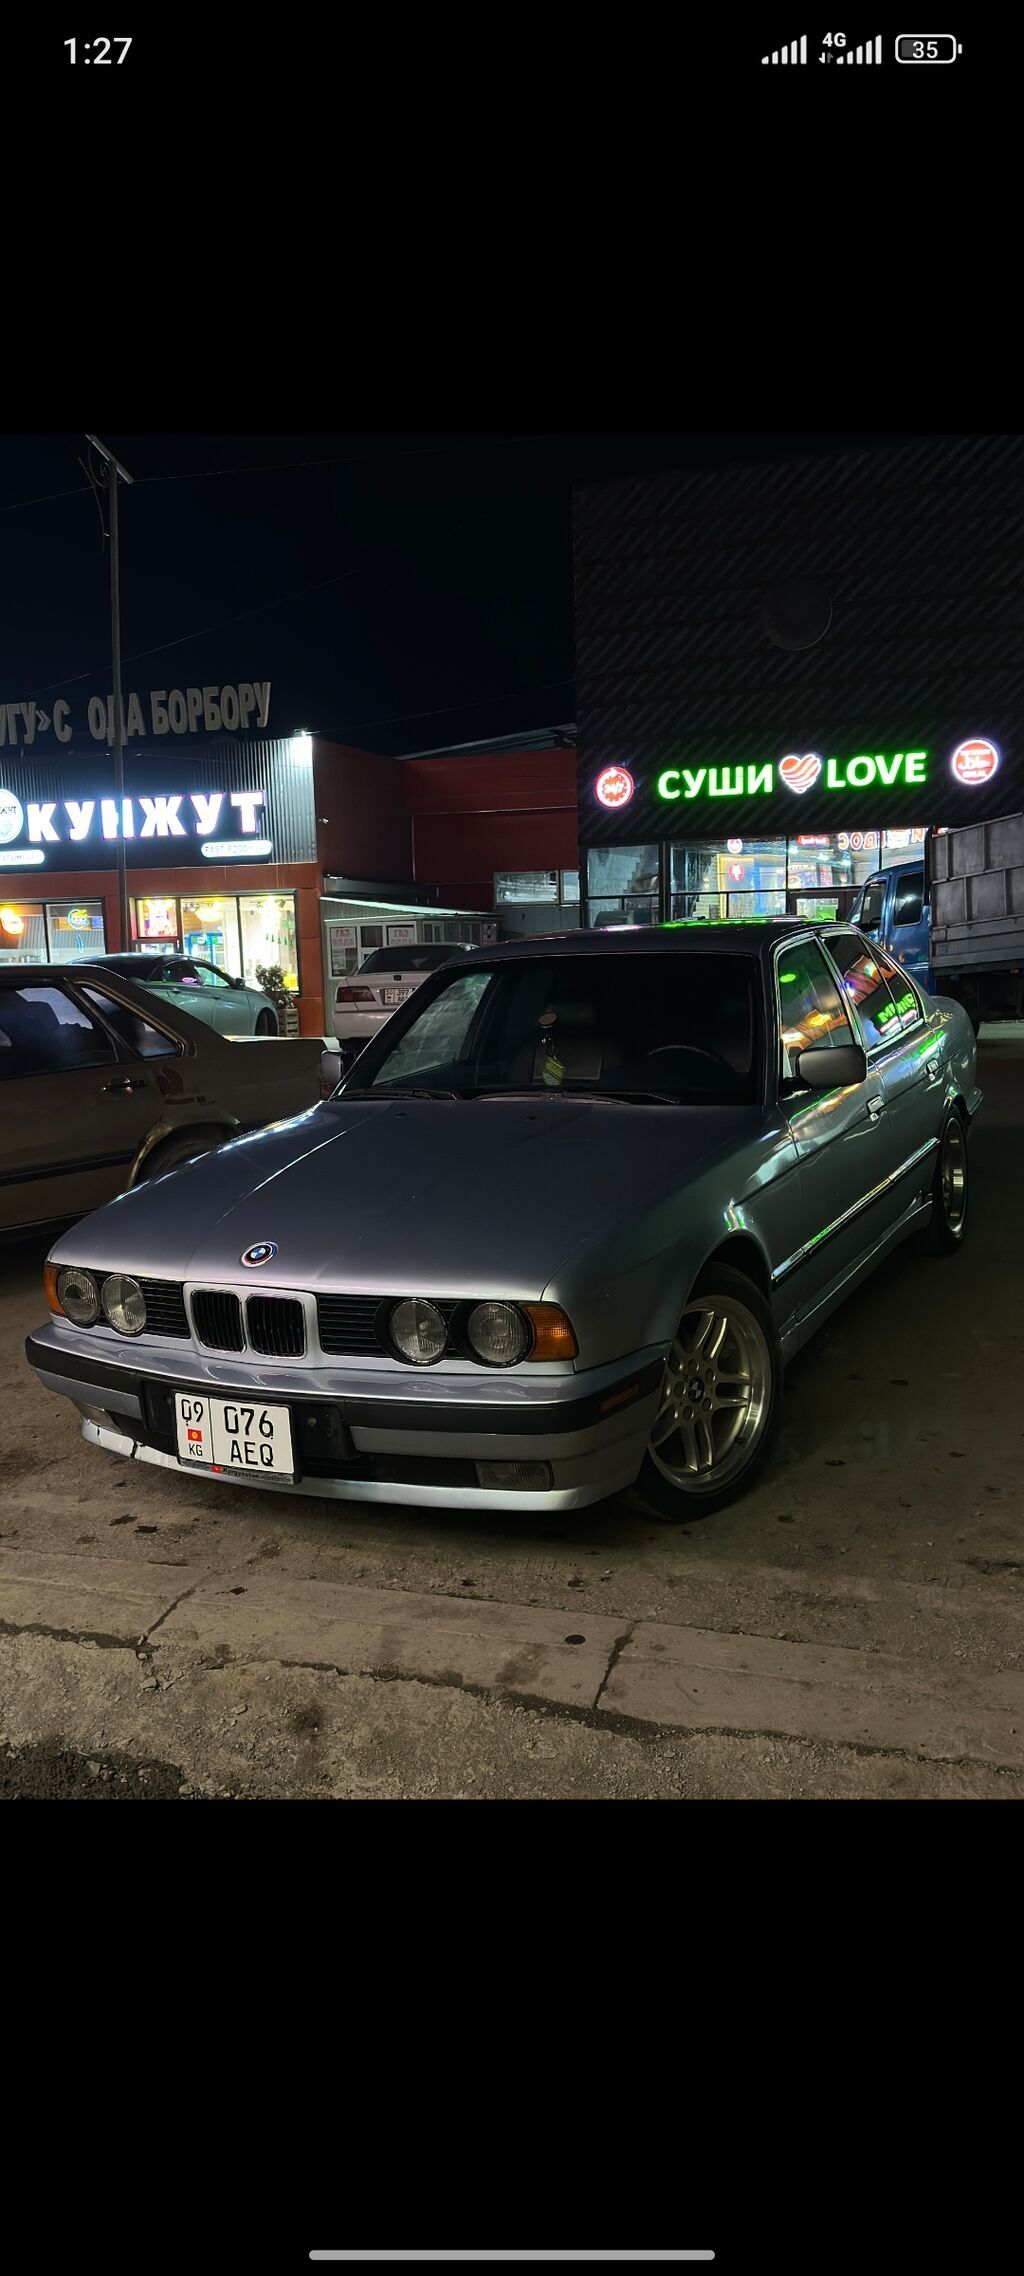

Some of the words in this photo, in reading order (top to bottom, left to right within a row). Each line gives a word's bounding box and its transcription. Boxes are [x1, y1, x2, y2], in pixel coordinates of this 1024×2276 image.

[150, 682, 272, 735] БОРБОРУ
[657, 764, 773, 800] СУШИ
[826, 751, 928, 790] LOVE
[27, 791, 266, 842] КУНЖУТ
[181, 1399, 204, 1423] 09
[223, 1405, 274, 1439] 076
[188, 1443, 203, 1456] KG
[230, 1440, 273, 1467] AEQ
